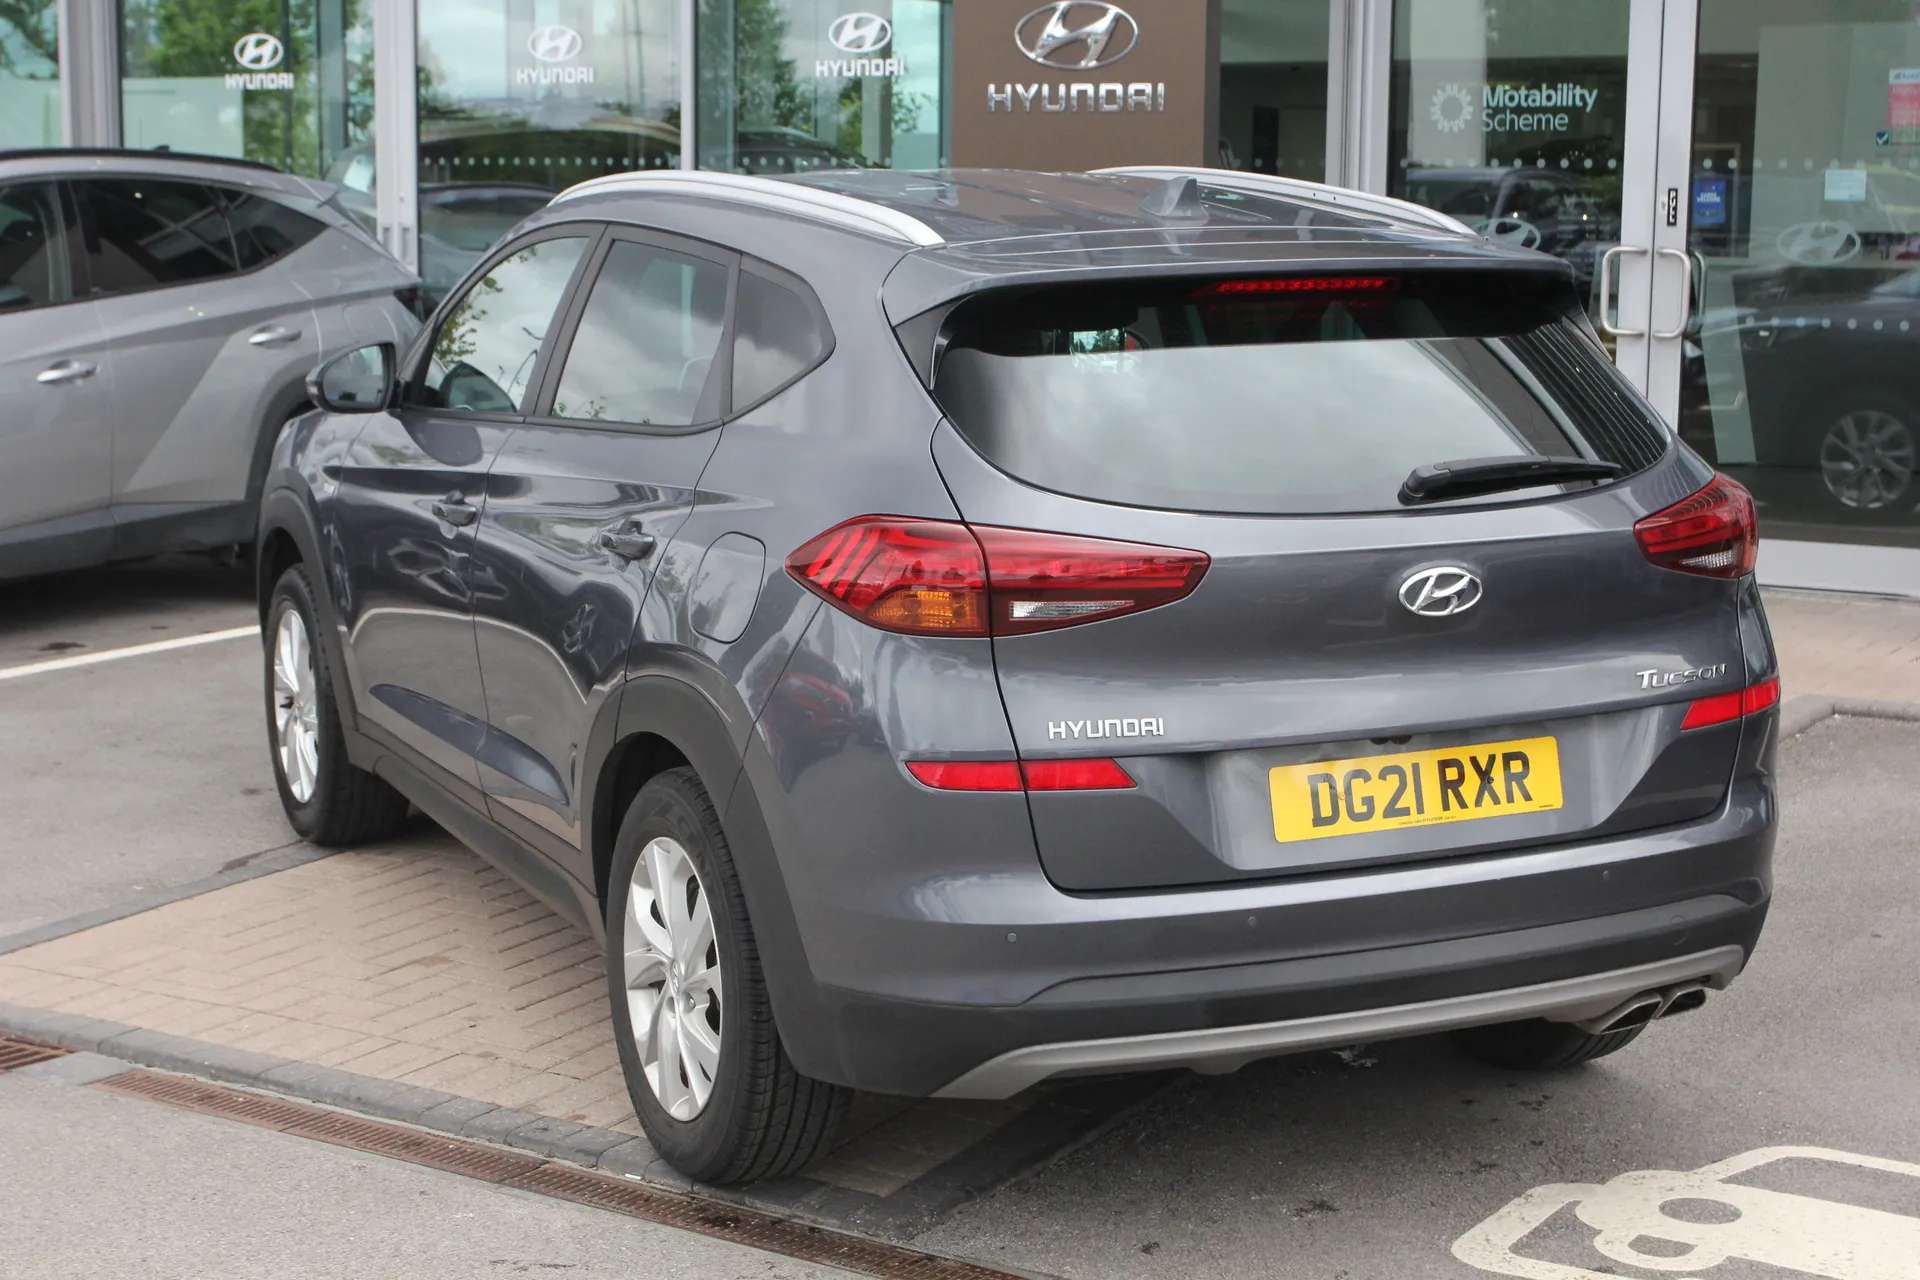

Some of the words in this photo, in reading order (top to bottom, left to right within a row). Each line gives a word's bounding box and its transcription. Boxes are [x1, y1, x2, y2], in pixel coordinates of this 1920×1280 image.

[516, 67, 594, 84] HYUNDAI
[815, 58, 905, 77] HYUNDAI
[225, 73, 295, 90] HYUNDAI
[988, 82, 1165, 112] HYUNDAI
[1482, 83, 1598, 113] Motability
[1482, 109, 1569, 132] Scheme
[1047, 717, 1165, 740] HYUNDAI
[1307, 761, 1425, 828] DG21
[1437, 750, 1533, 812] RXR
